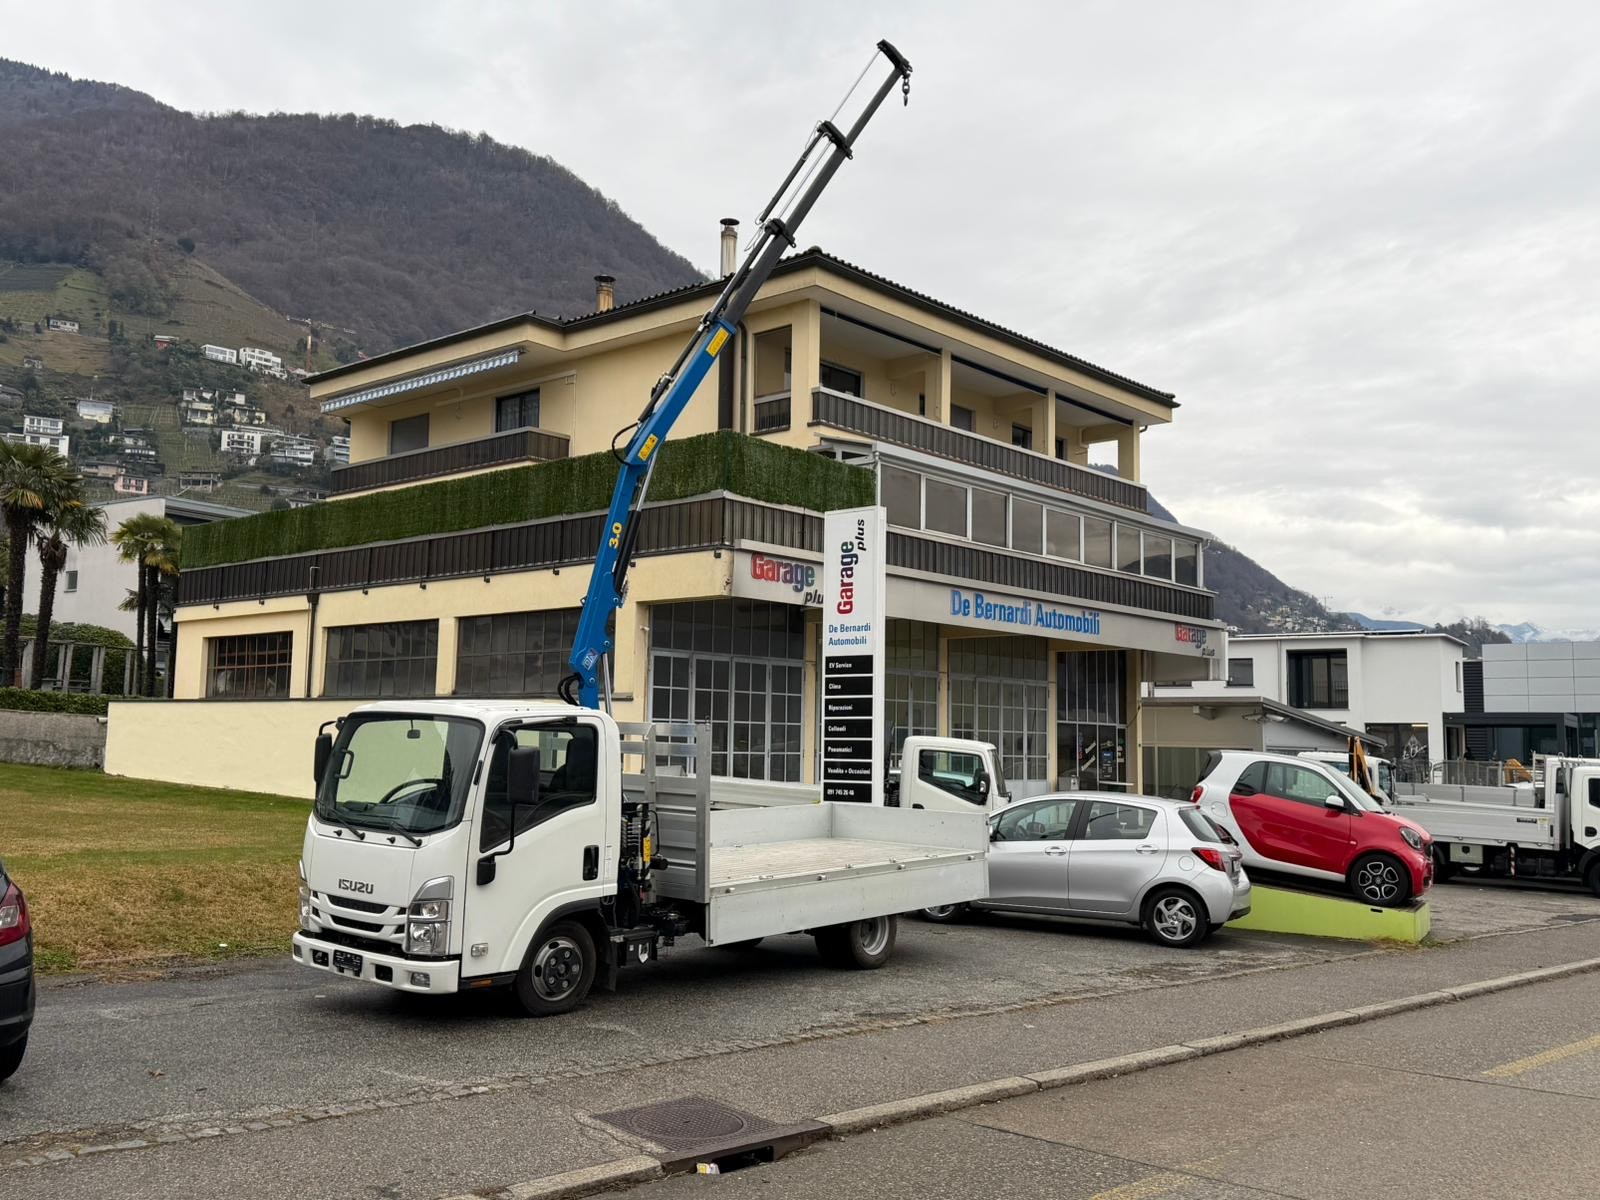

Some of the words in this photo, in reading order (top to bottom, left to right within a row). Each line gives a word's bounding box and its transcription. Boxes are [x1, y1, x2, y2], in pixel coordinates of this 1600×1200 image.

[609, 522, 623, 549] 3.0
[855, 519, 867, 551] plus
[751, 553, 816, 592] Garage
[837, 541, 859, 615] Garage
[804, 590, 824, 605] plu
[951, 590, 970, 617] De
[975, 592, 1032, 625] Bernardi
[1035, 603, 1101, 635] Automobili
[828, 624, 838, 633] De
[840, 622, 871, 632] Bernardi
[1175, 623, 1207, 649] Garage
[828, 636, 867, 646] Automobili
[338, 878, 374, 895] ISUZU
